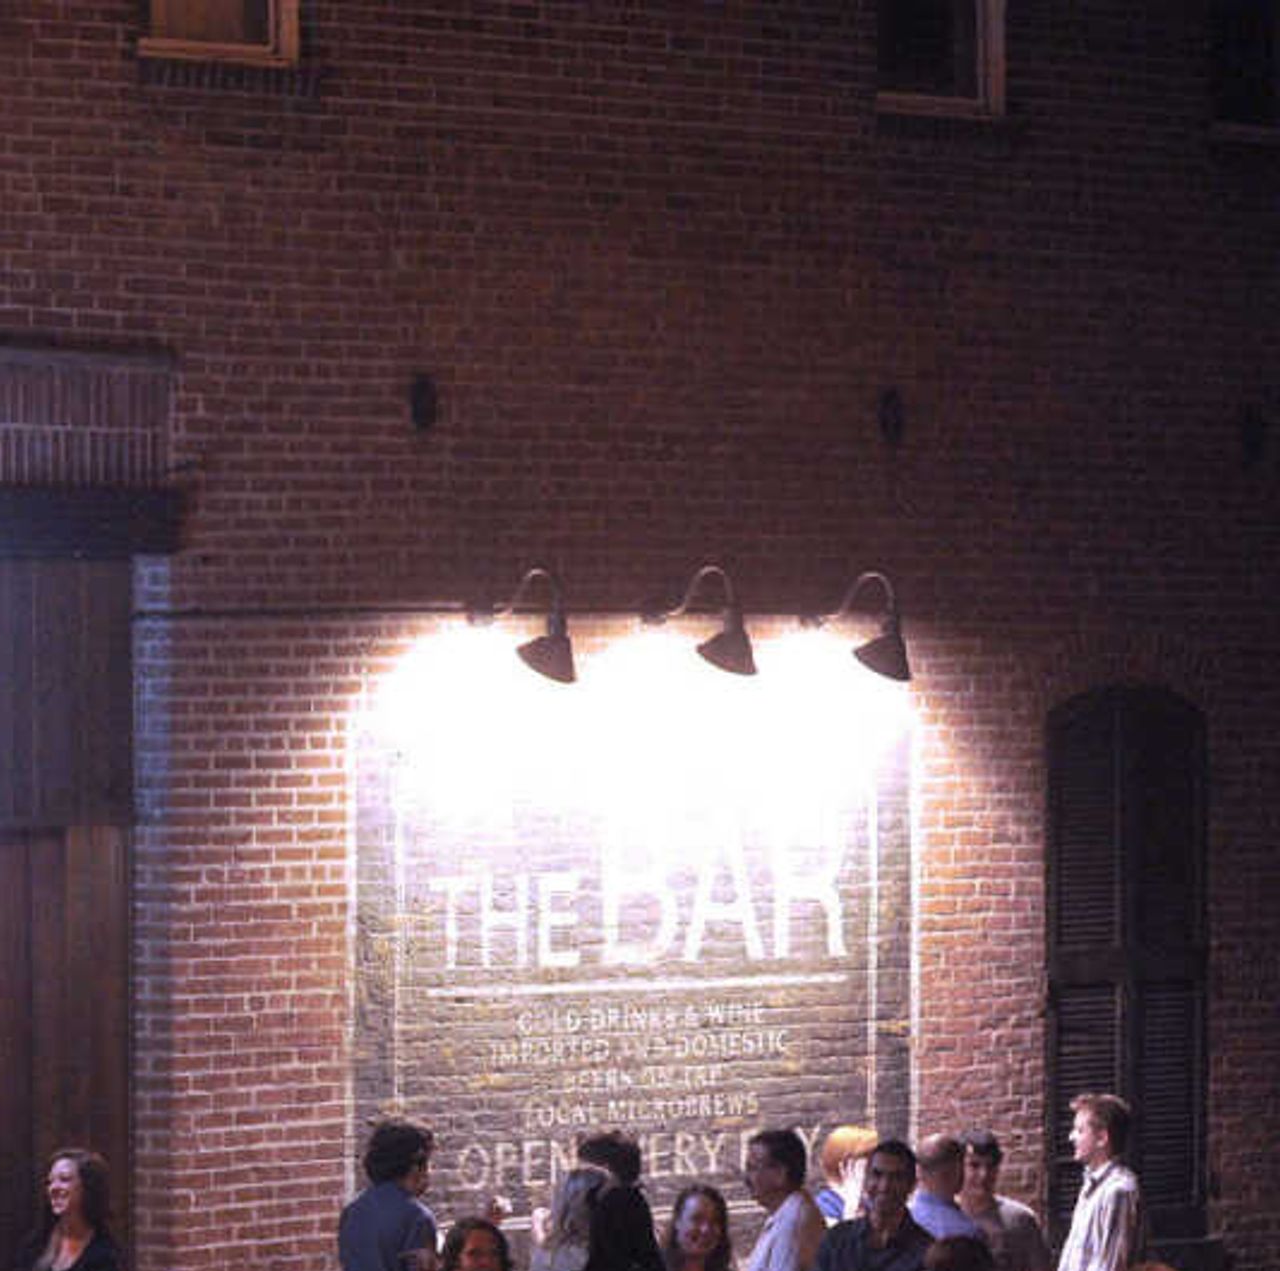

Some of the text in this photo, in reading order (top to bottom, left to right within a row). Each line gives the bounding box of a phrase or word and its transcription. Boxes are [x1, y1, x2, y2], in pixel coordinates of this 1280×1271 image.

[430, 872, 582, 970] THE
[675, 1026, 789, 1058] DOMESTIC
[457, 1137, 579, 1190] OPEN
